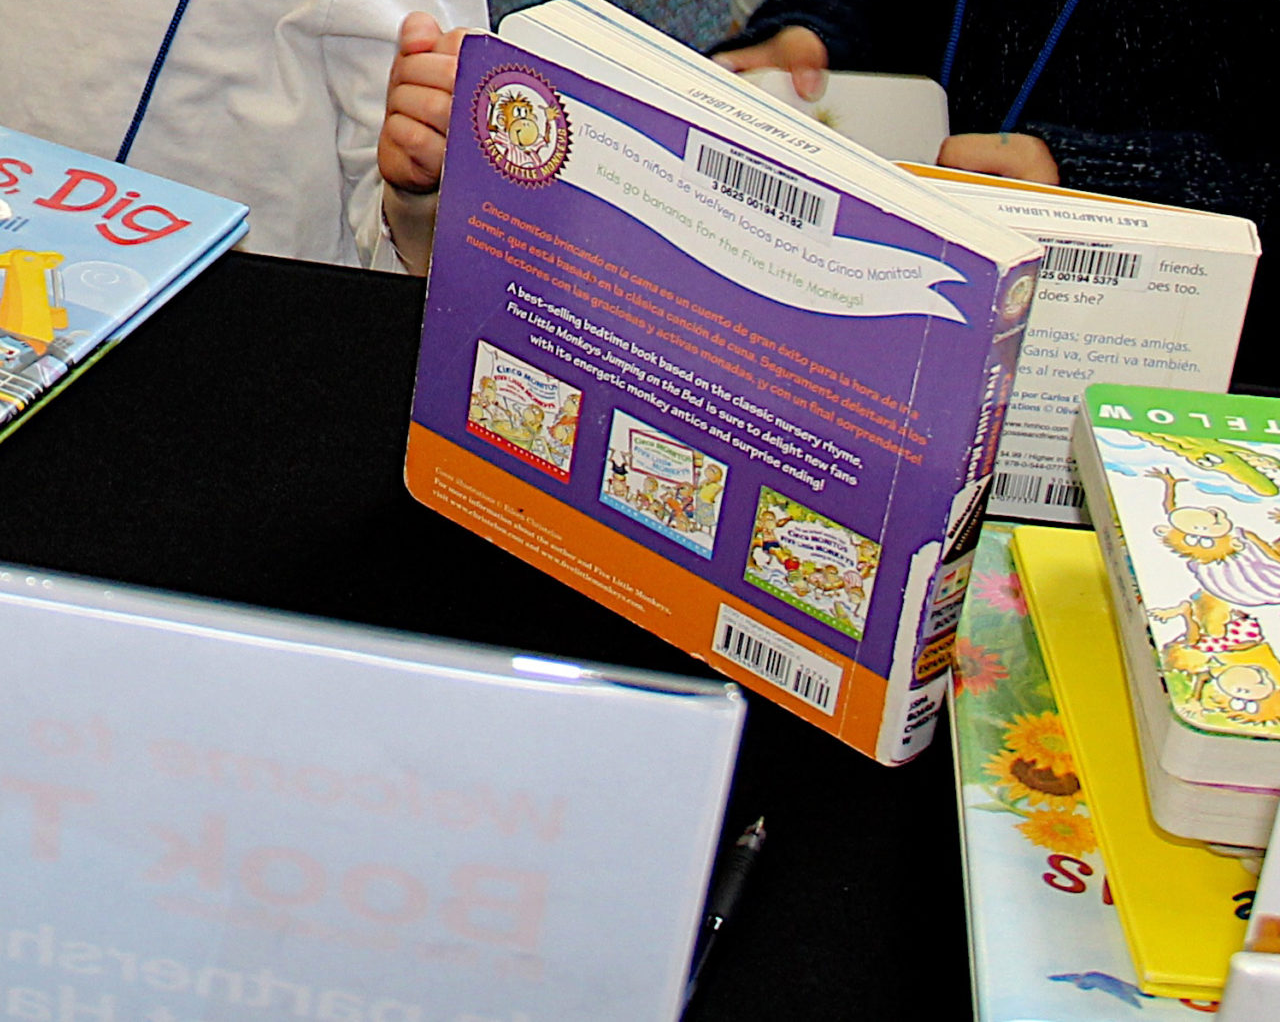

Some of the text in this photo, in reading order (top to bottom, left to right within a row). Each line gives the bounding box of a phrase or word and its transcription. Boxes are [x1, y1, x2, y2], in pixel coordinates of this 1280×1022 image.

[483, 128, 568, 179] FIVE LITTLE MONKEYS
[688, 87, 821, 155] EAST HAMPTON LIBRARY
[34, 168, 193, 246] Dig
[596, 164, 864, 308] Kids go bananas for the Five Little Monkeys!
[622, 144, 639, 163] los
[643, 158, 673, 184] niños
[676, 179, 691, 193] se
[694, 189, 736, 223] vuelven
[738, 215, 772, 243] locos
[775, 235, 799, 254] por
[802, 248, 825, 268] Los
[828, 257, 863, 280] Cinco
[712, 181, 803, 229] 3 0625 00194 2182
[998, 204, 1149, 228] EAST HAMPTON LIBRARY
[482, 201, 880, 400] Cinco monitos brincando cama cuento gran éxito para hora
[1038, 289, 1104, 305] does she?
[1039, 271, 1119, 286] 25 00194 5375
[1159, 260, 1209, 278] friends.
[1174, 282, 1200, 296] too.
[466, 235, 835, 422] nuevos lectores graciosas activas final
[528, 245, 898, 431] está basado clásica canción Seguramente deleitará
[1023, 345, 1201, 374] Gansi va, Gerti va también.
[1084, 333, 1137, 348] grandes
[1141, 338, 1192, 355] amigas.
[507, 281, 864, 470] A best-selling bedtime book based on the classic nursery rhyme.
[507, 301, 859, 486] Five Little Monkeys Jumping on the Bed is sure to delight new fans
[1036, 365, 1095, 380] al revés?
[1041, 392, 1070, 403] Carlos
[529, 333, 826, 491] with its energetic monkey antics and surprise ending!
[432, 488, 449, 502] visit
[525, 541, 540, 554] and
[513, 520, 536, 540] about
[550, 542, 577, 562] author
[593, 565, 612, 580] Five
[612, 573, 635, 593] Little
